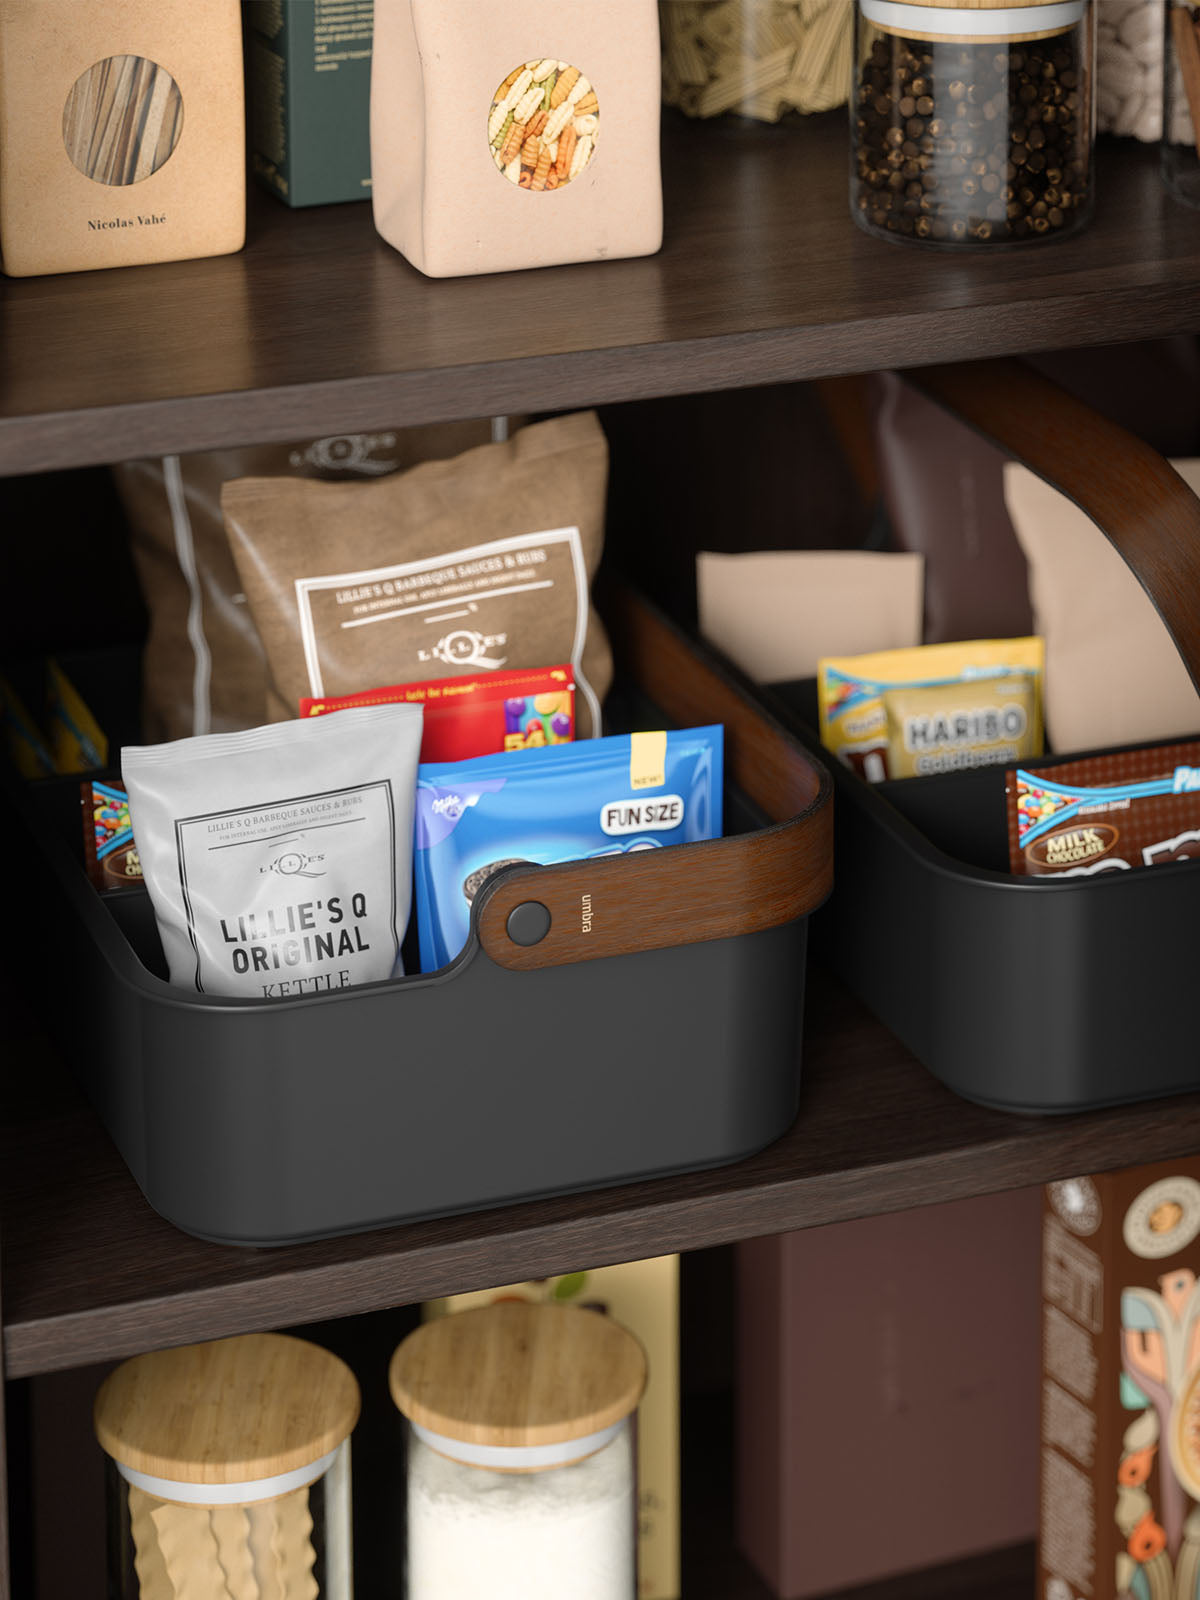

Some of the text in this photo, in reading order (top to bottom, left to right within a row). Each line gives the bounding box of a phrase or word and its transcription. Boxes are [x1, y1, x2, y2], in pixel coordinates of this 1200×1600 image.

[87, 212, 167, 231] Nicolas Vahé
[909, 708, 1023, 747] HARIBO
[243, 818, 251, 828] Q
[253, 809, 298, 825] BARBEQUE
[300, 802, 332, 816] SAUCES
[607, 802, 679, 827] FUN SIZE
[1046, 828, 1100, 853] MILK
[1046, 839, 1105, 864] CHOCOLATE
[220, 892, 368, 943] LILLIE'S Q
[582, 894, 594, 933] umbra
[232, 926, 371, 974] ORIGINAL
[262, 969, 351, 999] KETTLE
